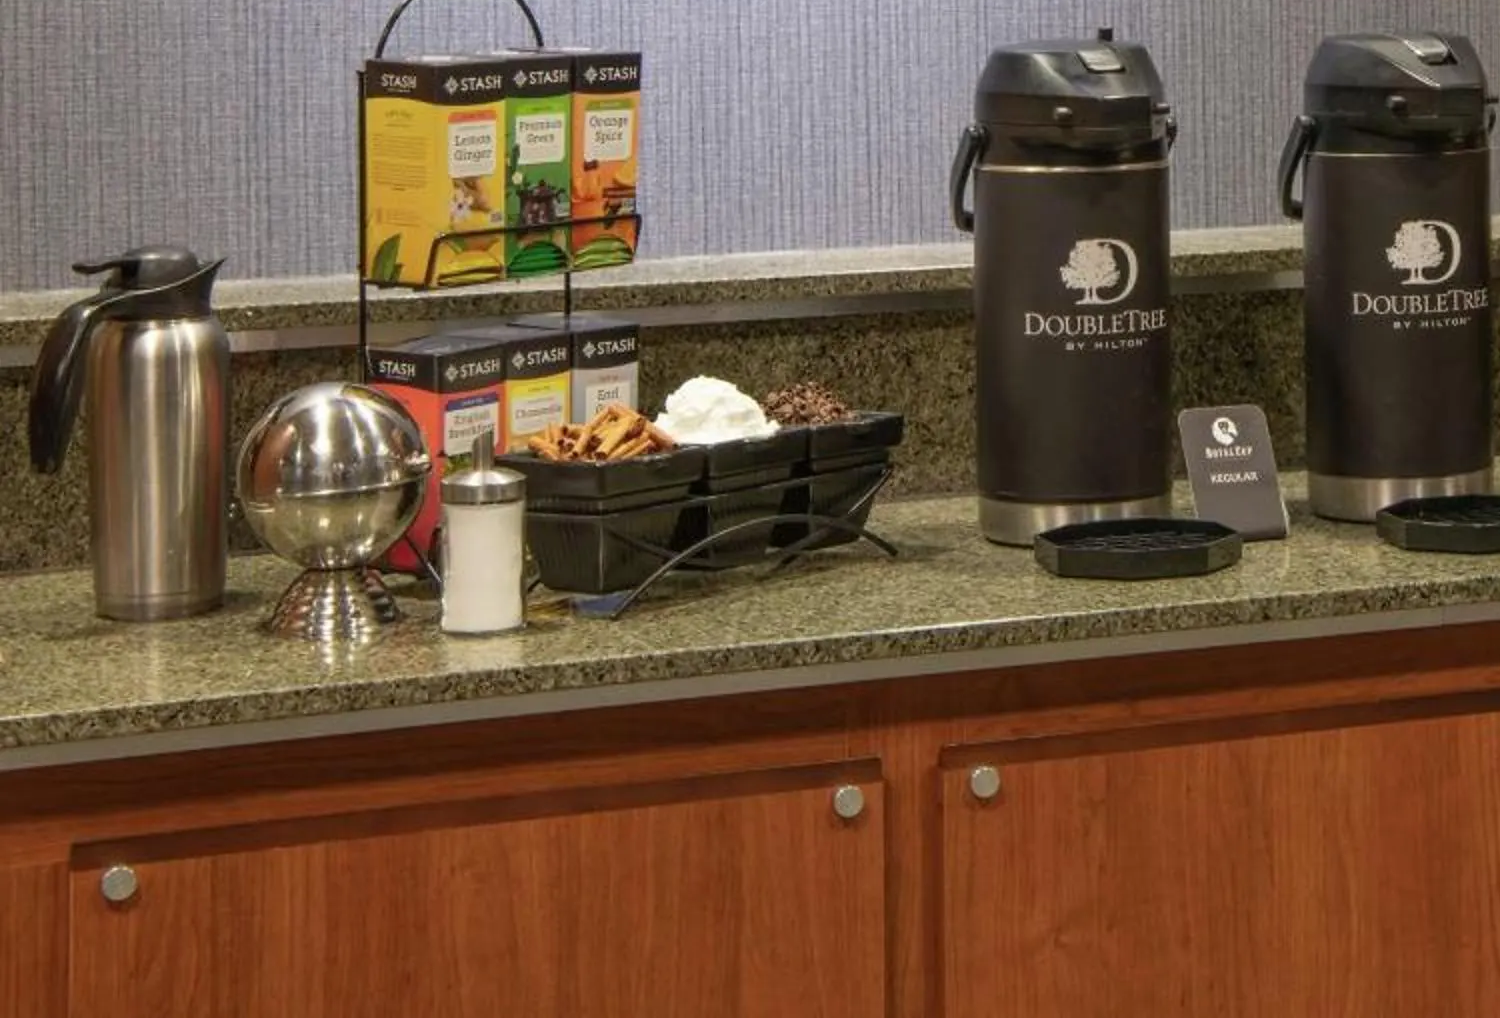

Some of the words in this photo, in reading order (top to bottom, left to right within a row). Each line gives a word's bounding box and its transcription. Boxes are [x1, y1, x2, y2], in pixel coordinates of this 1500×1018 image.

[381, 73, 417, 89] STASH
[529, 70, 569, 85] STASH
[599, 66, 637, 82] STASH
[461, 75, 502, 91] STASH
[589, 115, 628, 129] Orange
[455, 134, 492, 147] Lemon
[527, 133, 555, 144] Green
[595, 131, 623, 144] Spice
[453, 149, 493, 163] Ginger
[1420, 317, 1468, 328] HILTON
[597, 337, 636, 355] STASH
[1065, 342, 1084, 350] BY
[1094, 338, 1143, 349] HILTON
[527, 347, 568, 365] STASH
[379, 359, 416, 377] STASH
[460, 358, 500, 379] STASH
[597, 388, 619, 400] Earl
[1210, 471, 1258, 483] REGULAR
